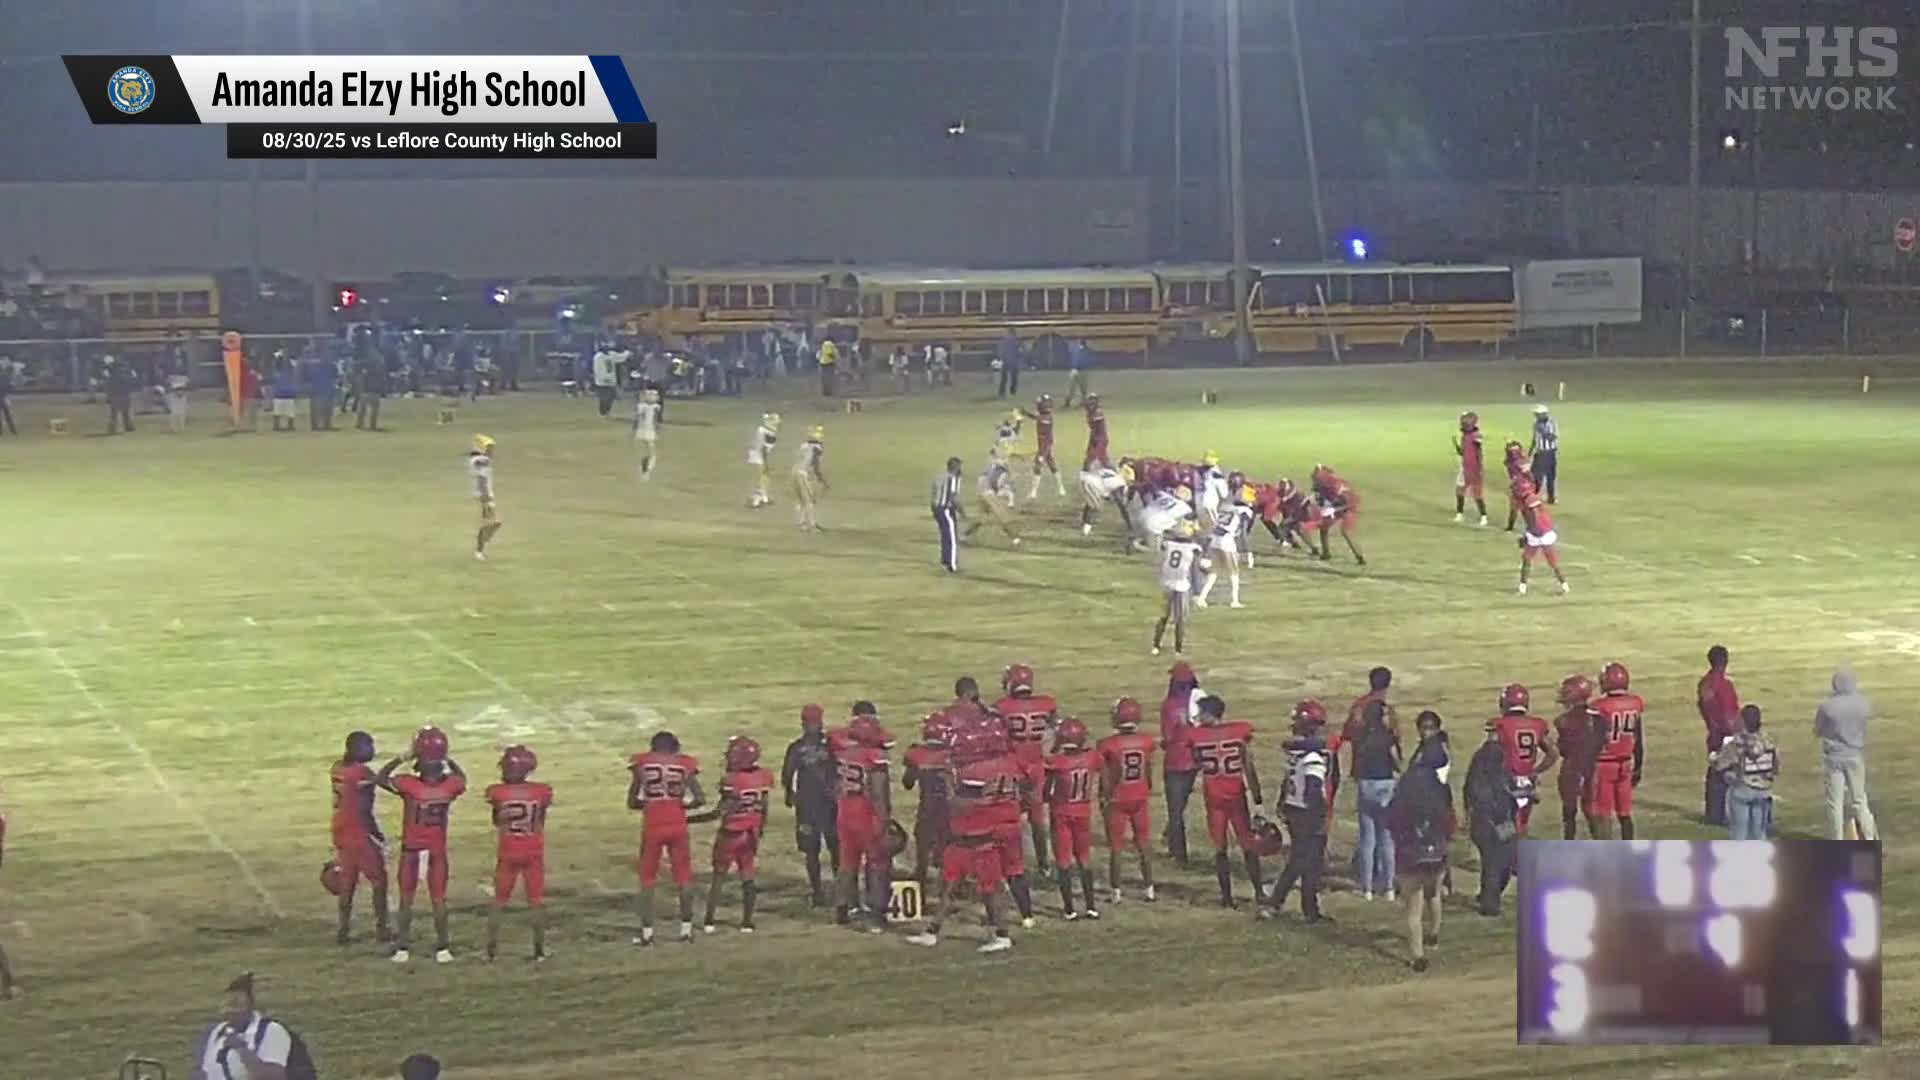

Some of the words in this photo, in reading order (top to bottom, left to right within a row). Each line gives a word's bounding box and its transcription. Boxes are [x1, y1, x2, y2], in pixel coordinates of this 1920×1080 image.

[1169, 549, 1182, 569] 8
[1610, 709, 1640, 744] 14
[1193, 738, 1245, 776] 52
[1515, 729, 1538, 760] 9
[1122, 749, 1145, 783] 8
[504, 800, 541, 836] 21
[886, 885, 919, 920] 40
